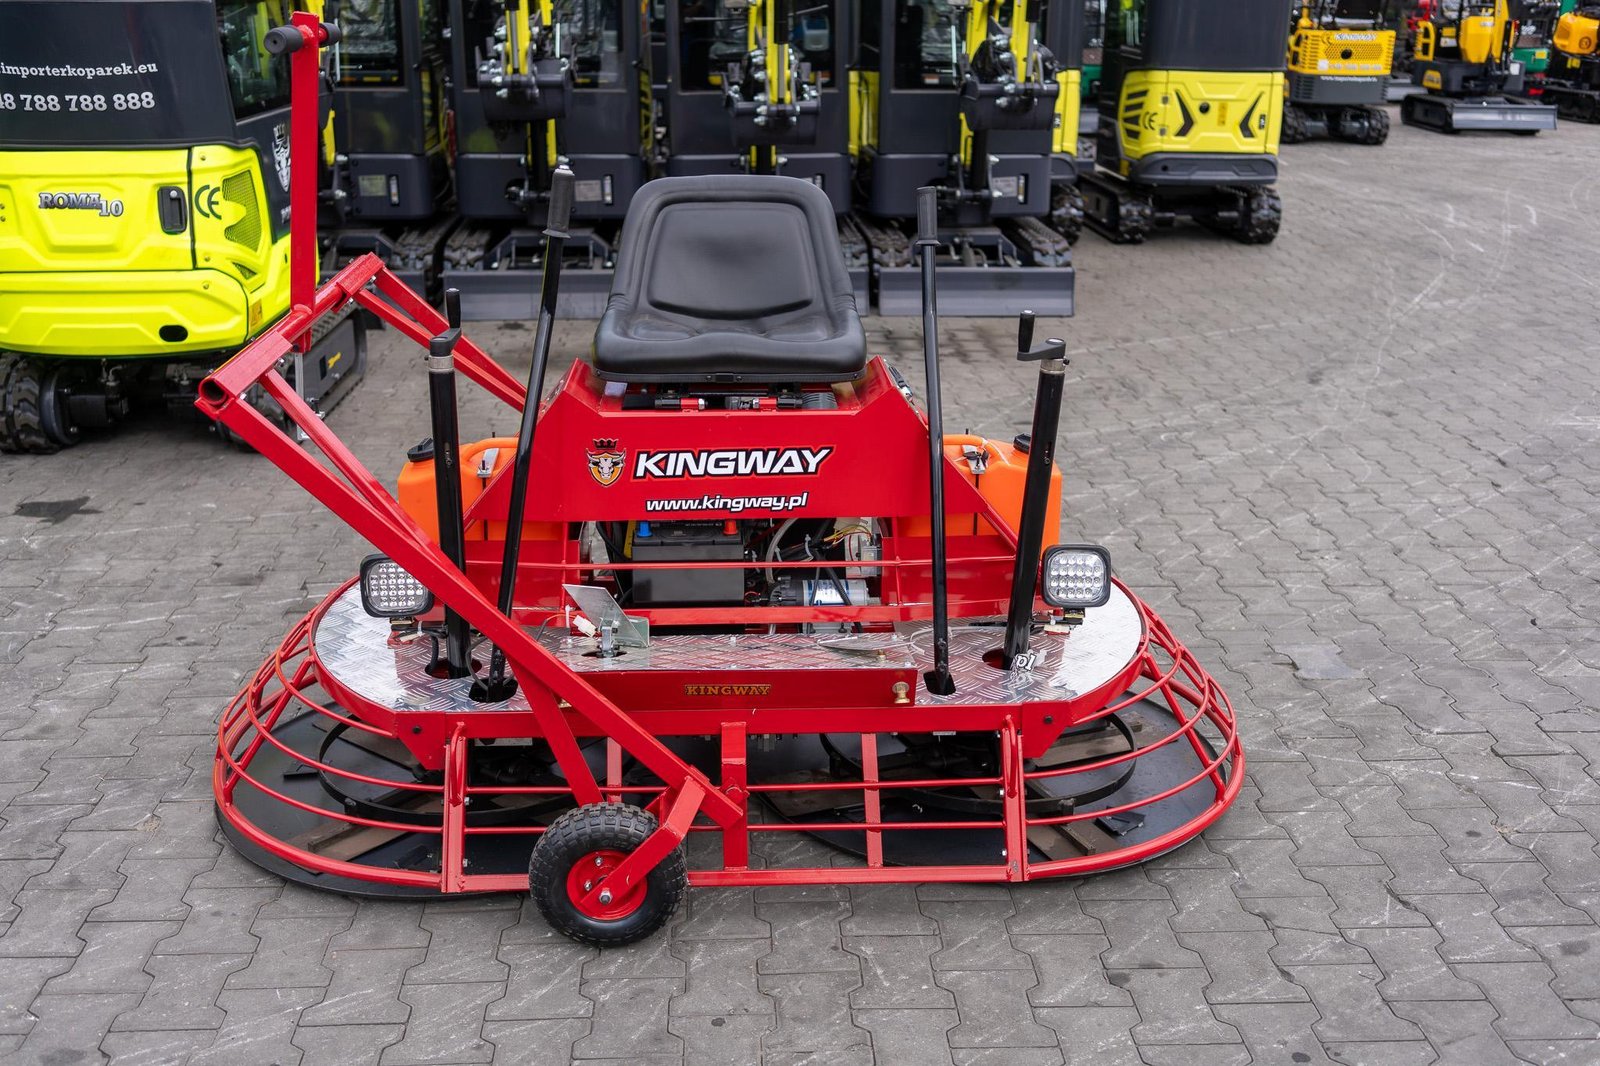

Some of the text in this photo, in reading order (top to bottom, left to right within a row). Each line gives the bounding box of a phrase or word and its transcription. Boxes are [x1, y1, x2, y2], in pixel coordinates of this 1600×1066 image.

[0, 61, 159, 80] importerkoparek.eu
[19, 94, 61, 112] 788
[64, 94, 108, 112] 788
[112, 91, 156, 111] 888
[38, 192, 101, 210] ROMA
[634, 447, 833, 478] KINGWAY
[645, 492, 808, 513] www.kingway.pl
[686, 685, 771, 696] KINGWAY
